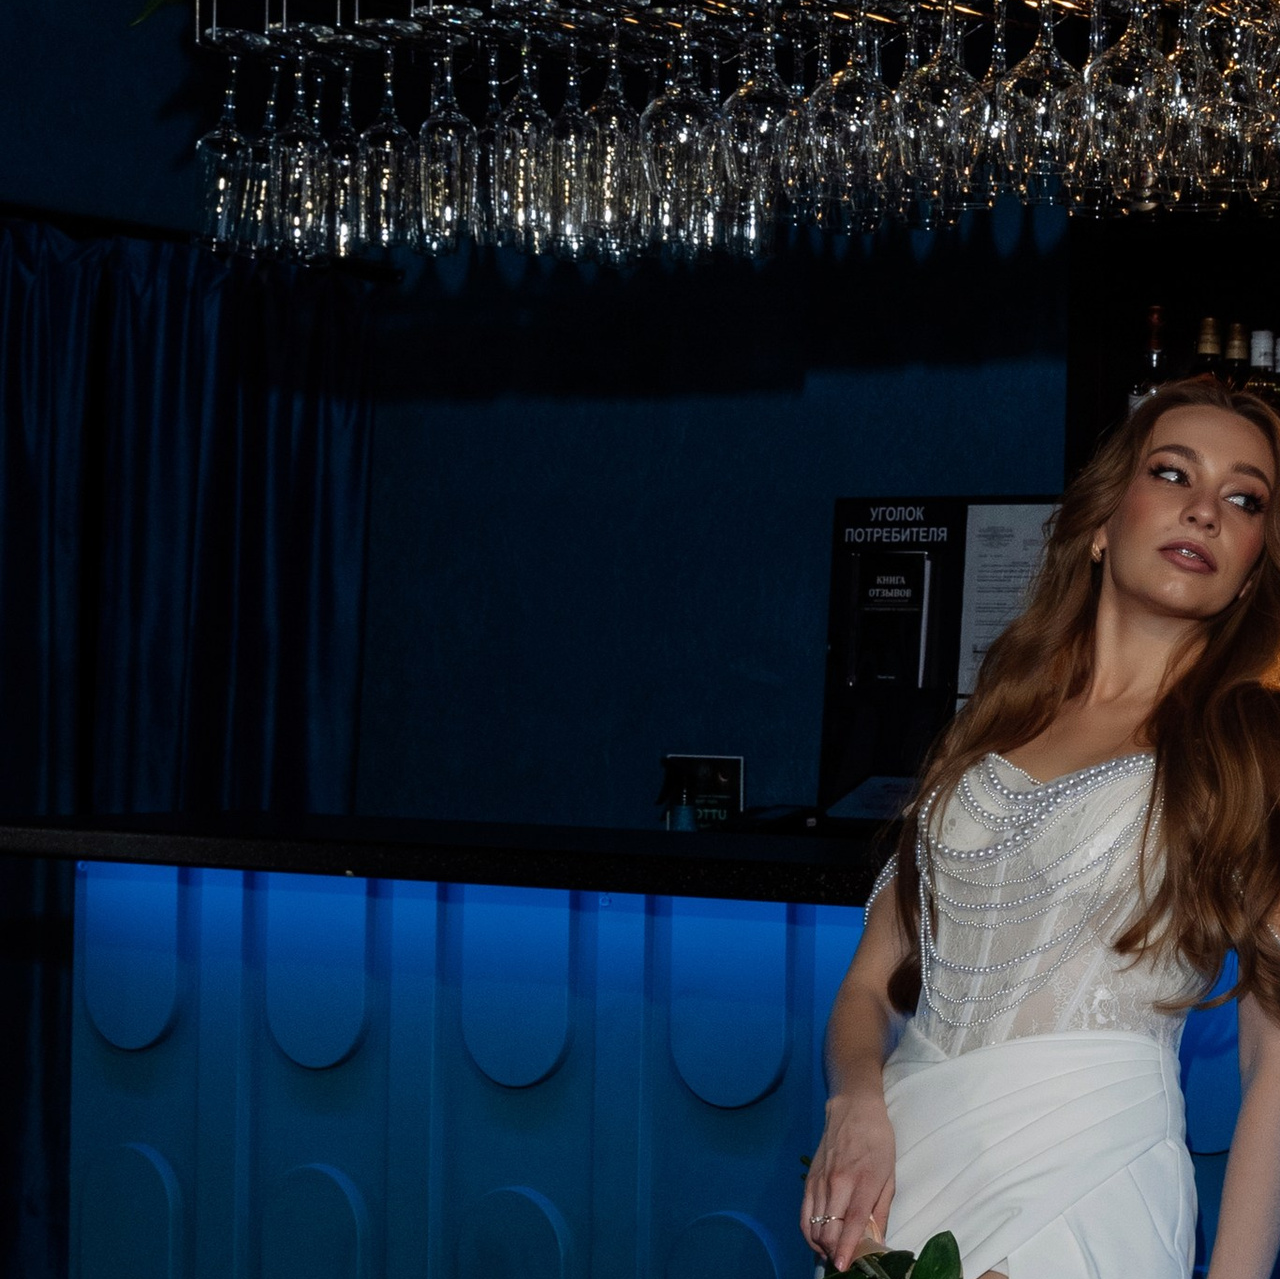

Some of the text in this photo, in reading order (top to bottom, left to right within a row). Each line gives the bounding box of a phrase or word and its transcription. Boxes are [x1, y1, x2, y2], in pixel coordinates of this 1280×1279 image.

[869, 505, 926, 522] УГОЛОК
[844, 527, 949, 543] ПОТРЕБИТЕЛЯ
[876, 575, 906, 585] КНИГА
[868, 588, 912, 598] ОТЗЫВОВ
